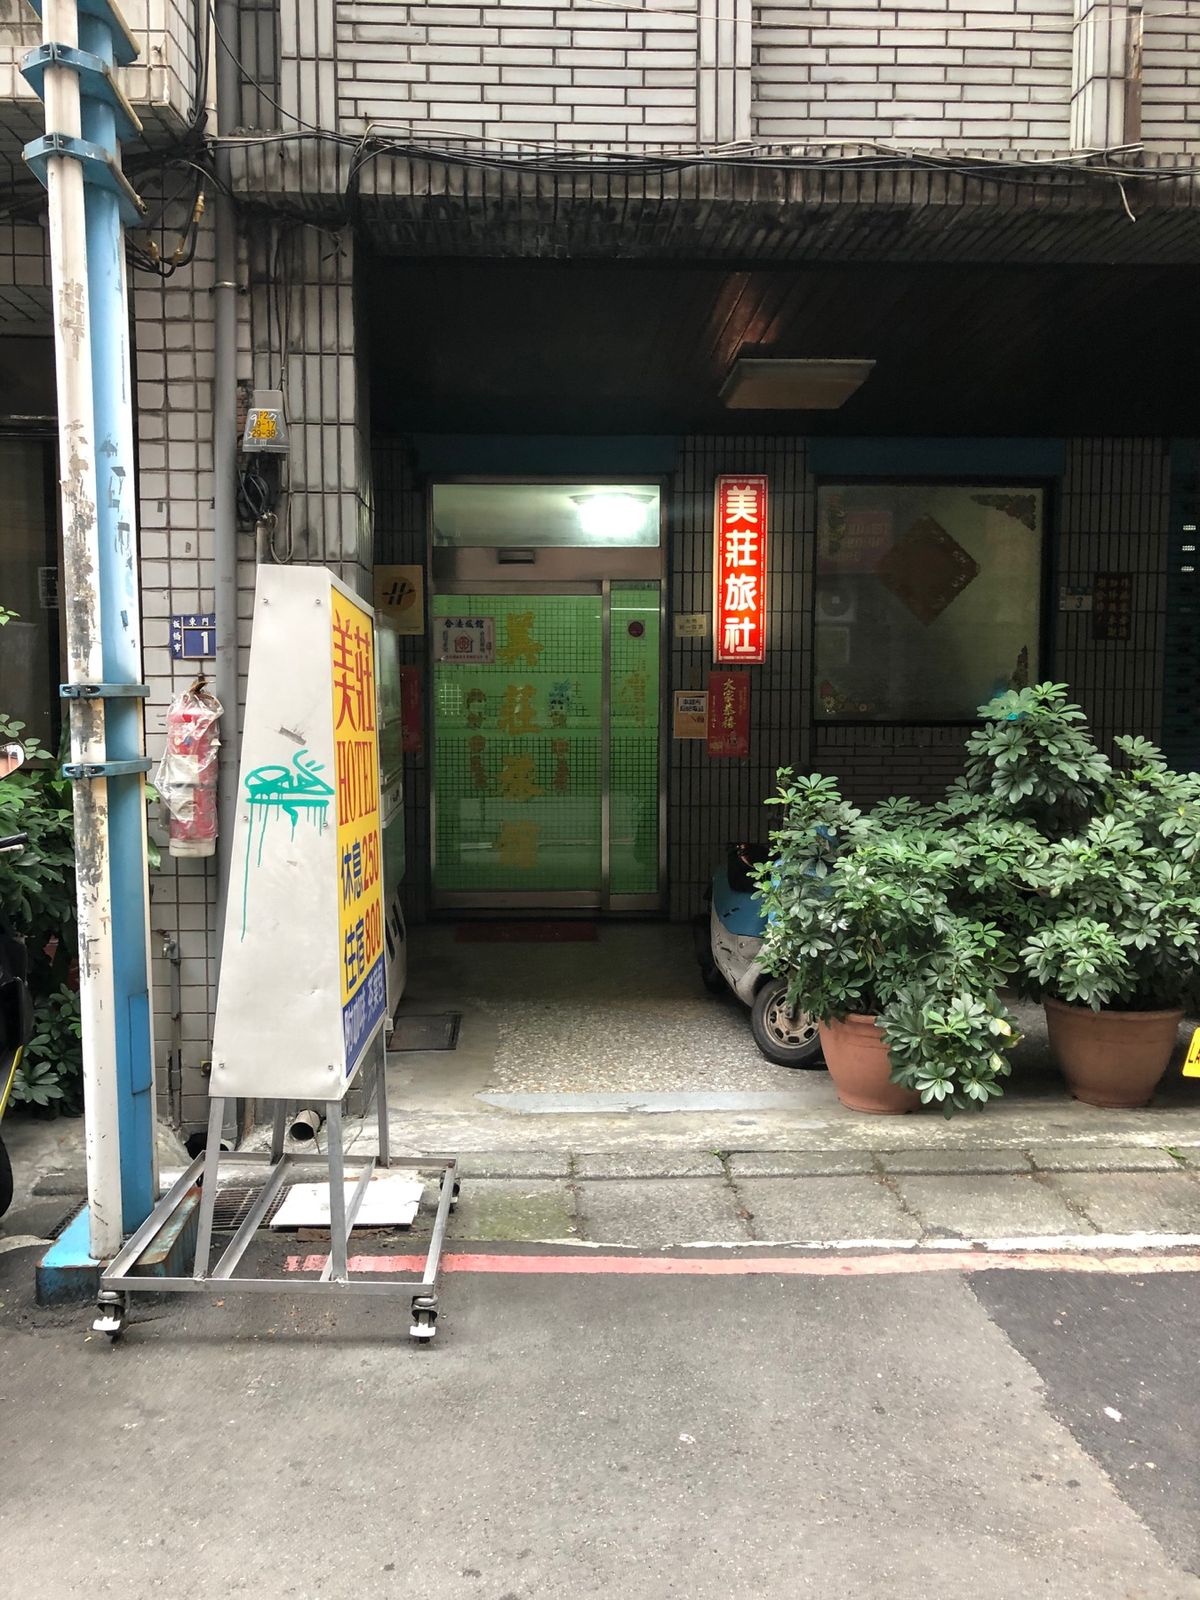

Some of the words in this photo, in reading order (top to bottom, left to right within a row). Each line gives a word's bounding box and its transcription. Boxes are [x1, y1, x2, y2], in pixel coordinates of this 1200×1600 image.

[724, 485, 758, 653] 美莊旅社
[173, 620, 182, 653] 板橋市
[189, 616, 216, 627] 東門
[332, 608, 375, 732] 美莊
[337, 740, 377, 827] HOTEL
